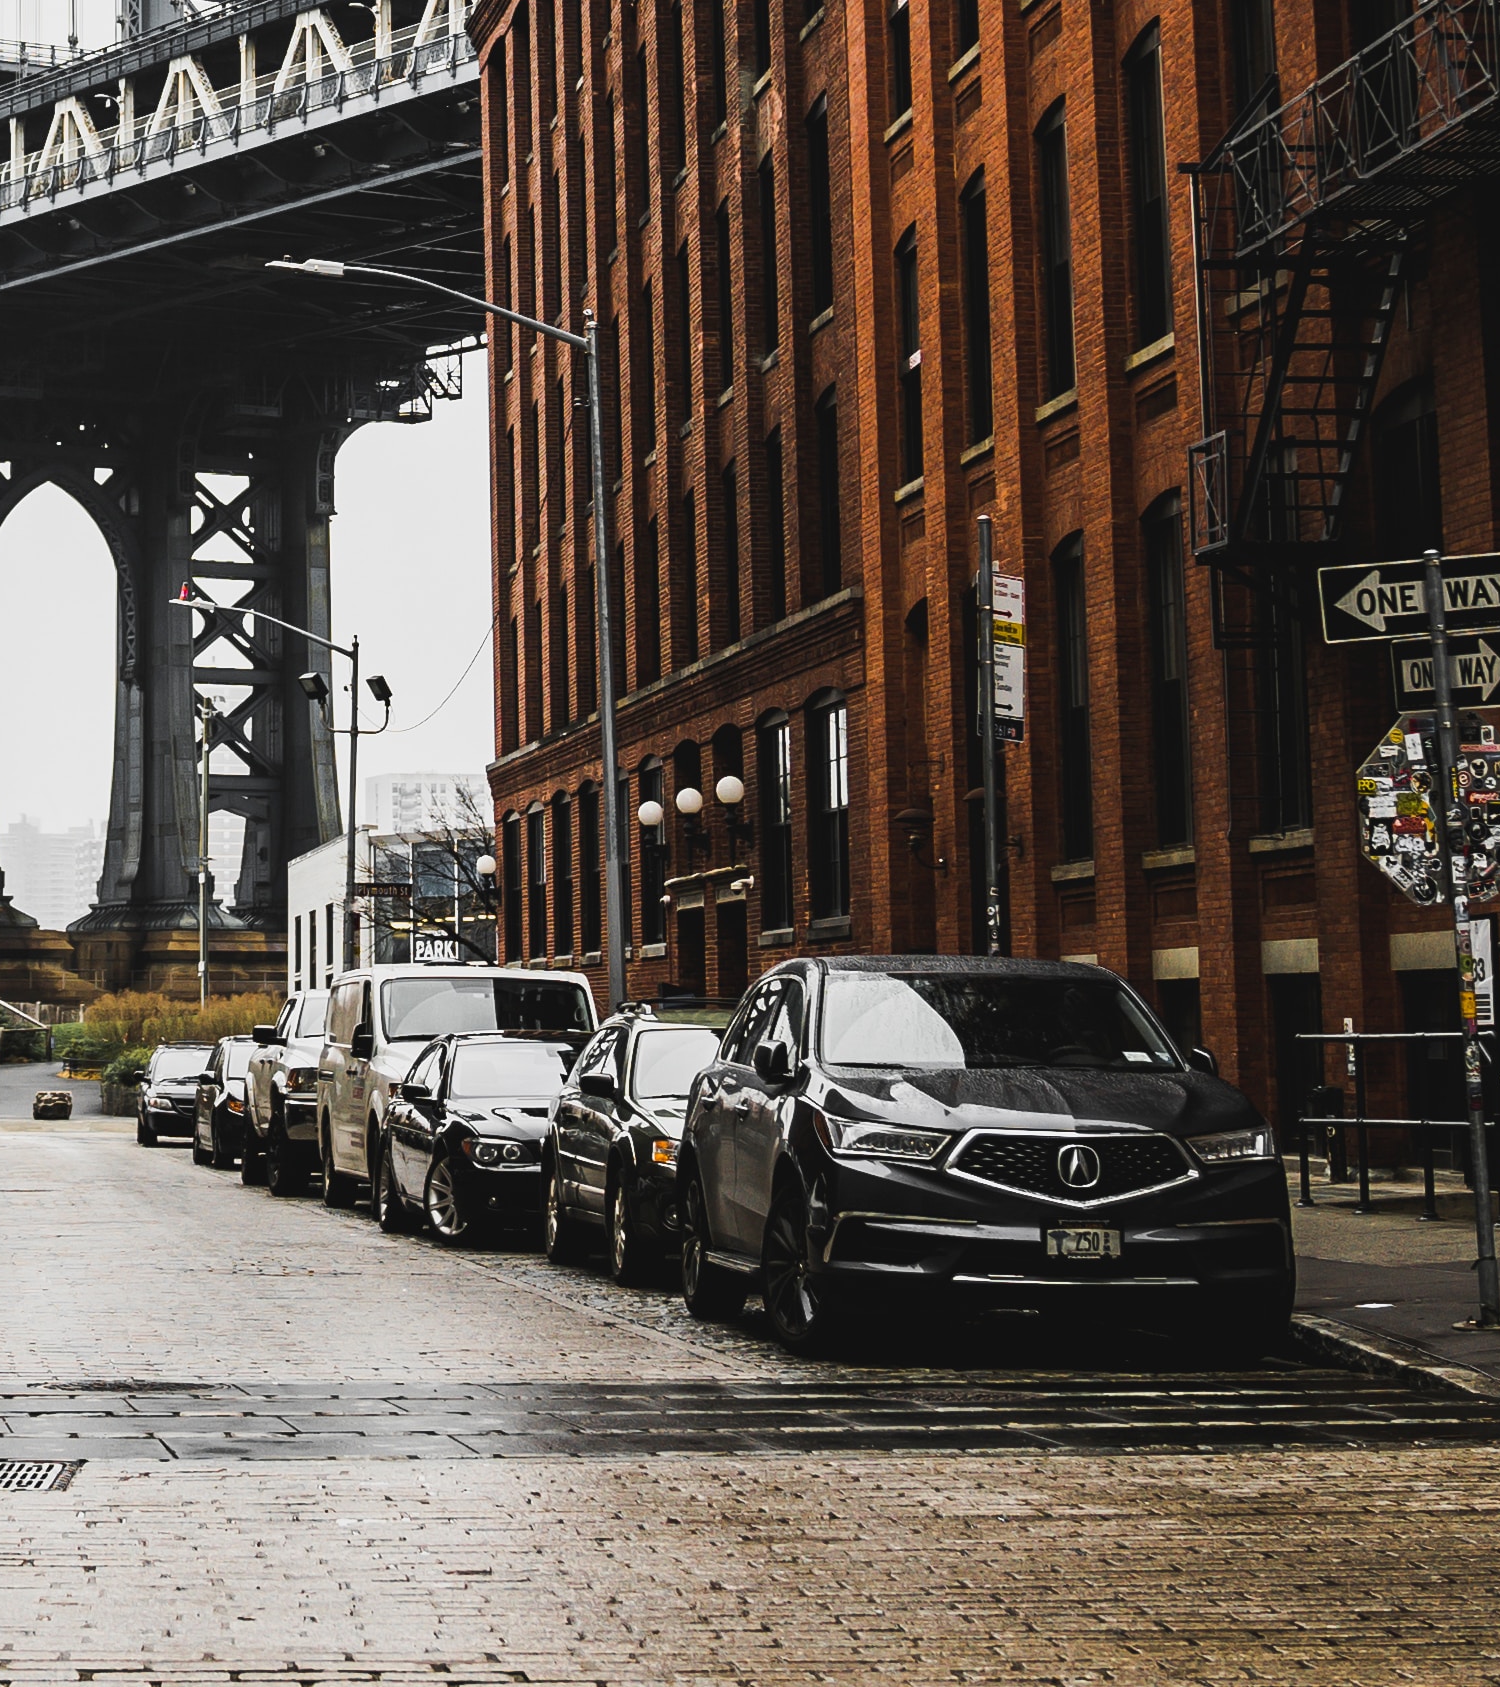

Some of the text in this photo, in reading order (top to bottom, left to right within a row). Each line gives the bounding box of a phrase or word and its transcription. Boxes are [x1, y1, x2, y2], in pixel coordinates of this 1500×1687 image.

[1356, 584, 1419, 616] ONE
[1410, 655, 1497, 689] ON WAY
[358, 886, 408, 896] Plymouth St
[415, 940, 455, 959] PARK
